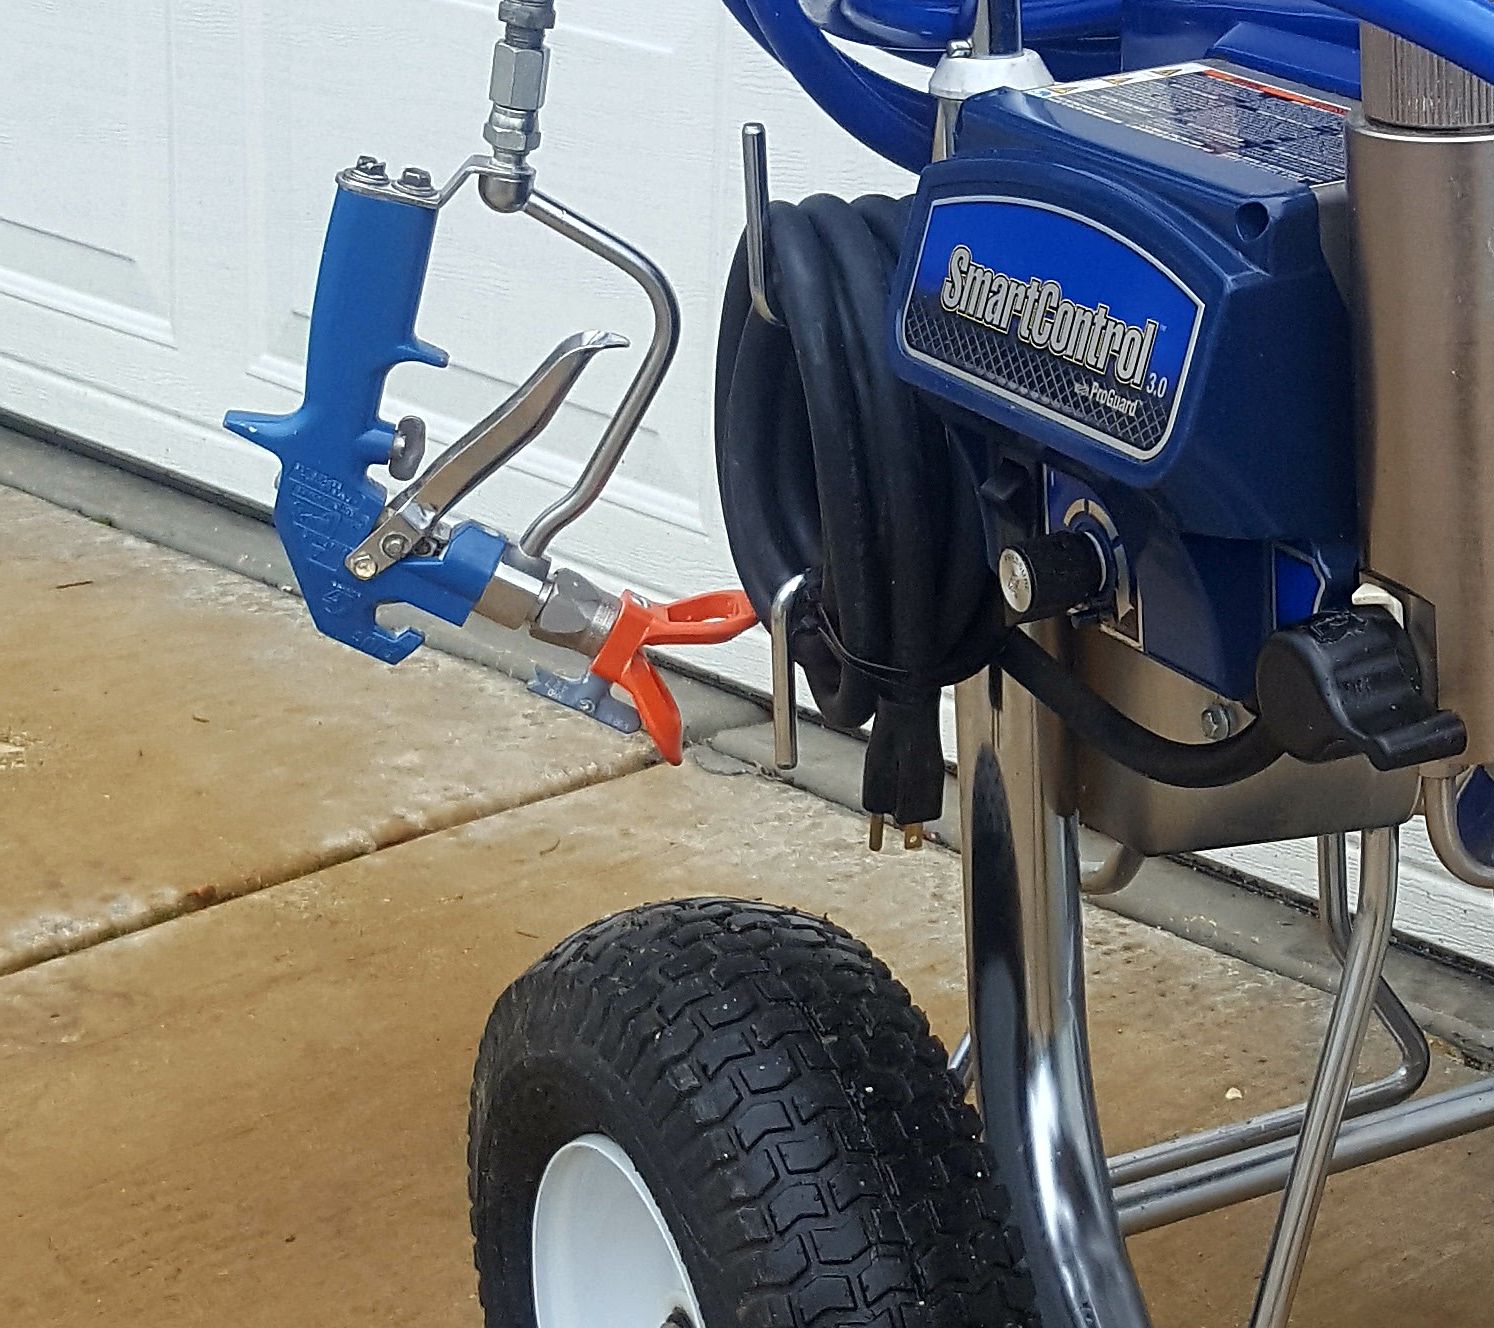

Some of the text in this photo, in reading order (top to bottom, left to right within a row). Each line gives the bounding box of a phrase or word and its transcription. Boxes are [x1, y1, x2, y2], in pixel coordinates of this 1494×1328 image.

[941, 245, 1168, 400] SmartControl 3.0
[1089, 381, 1138, 417] ProGuard
